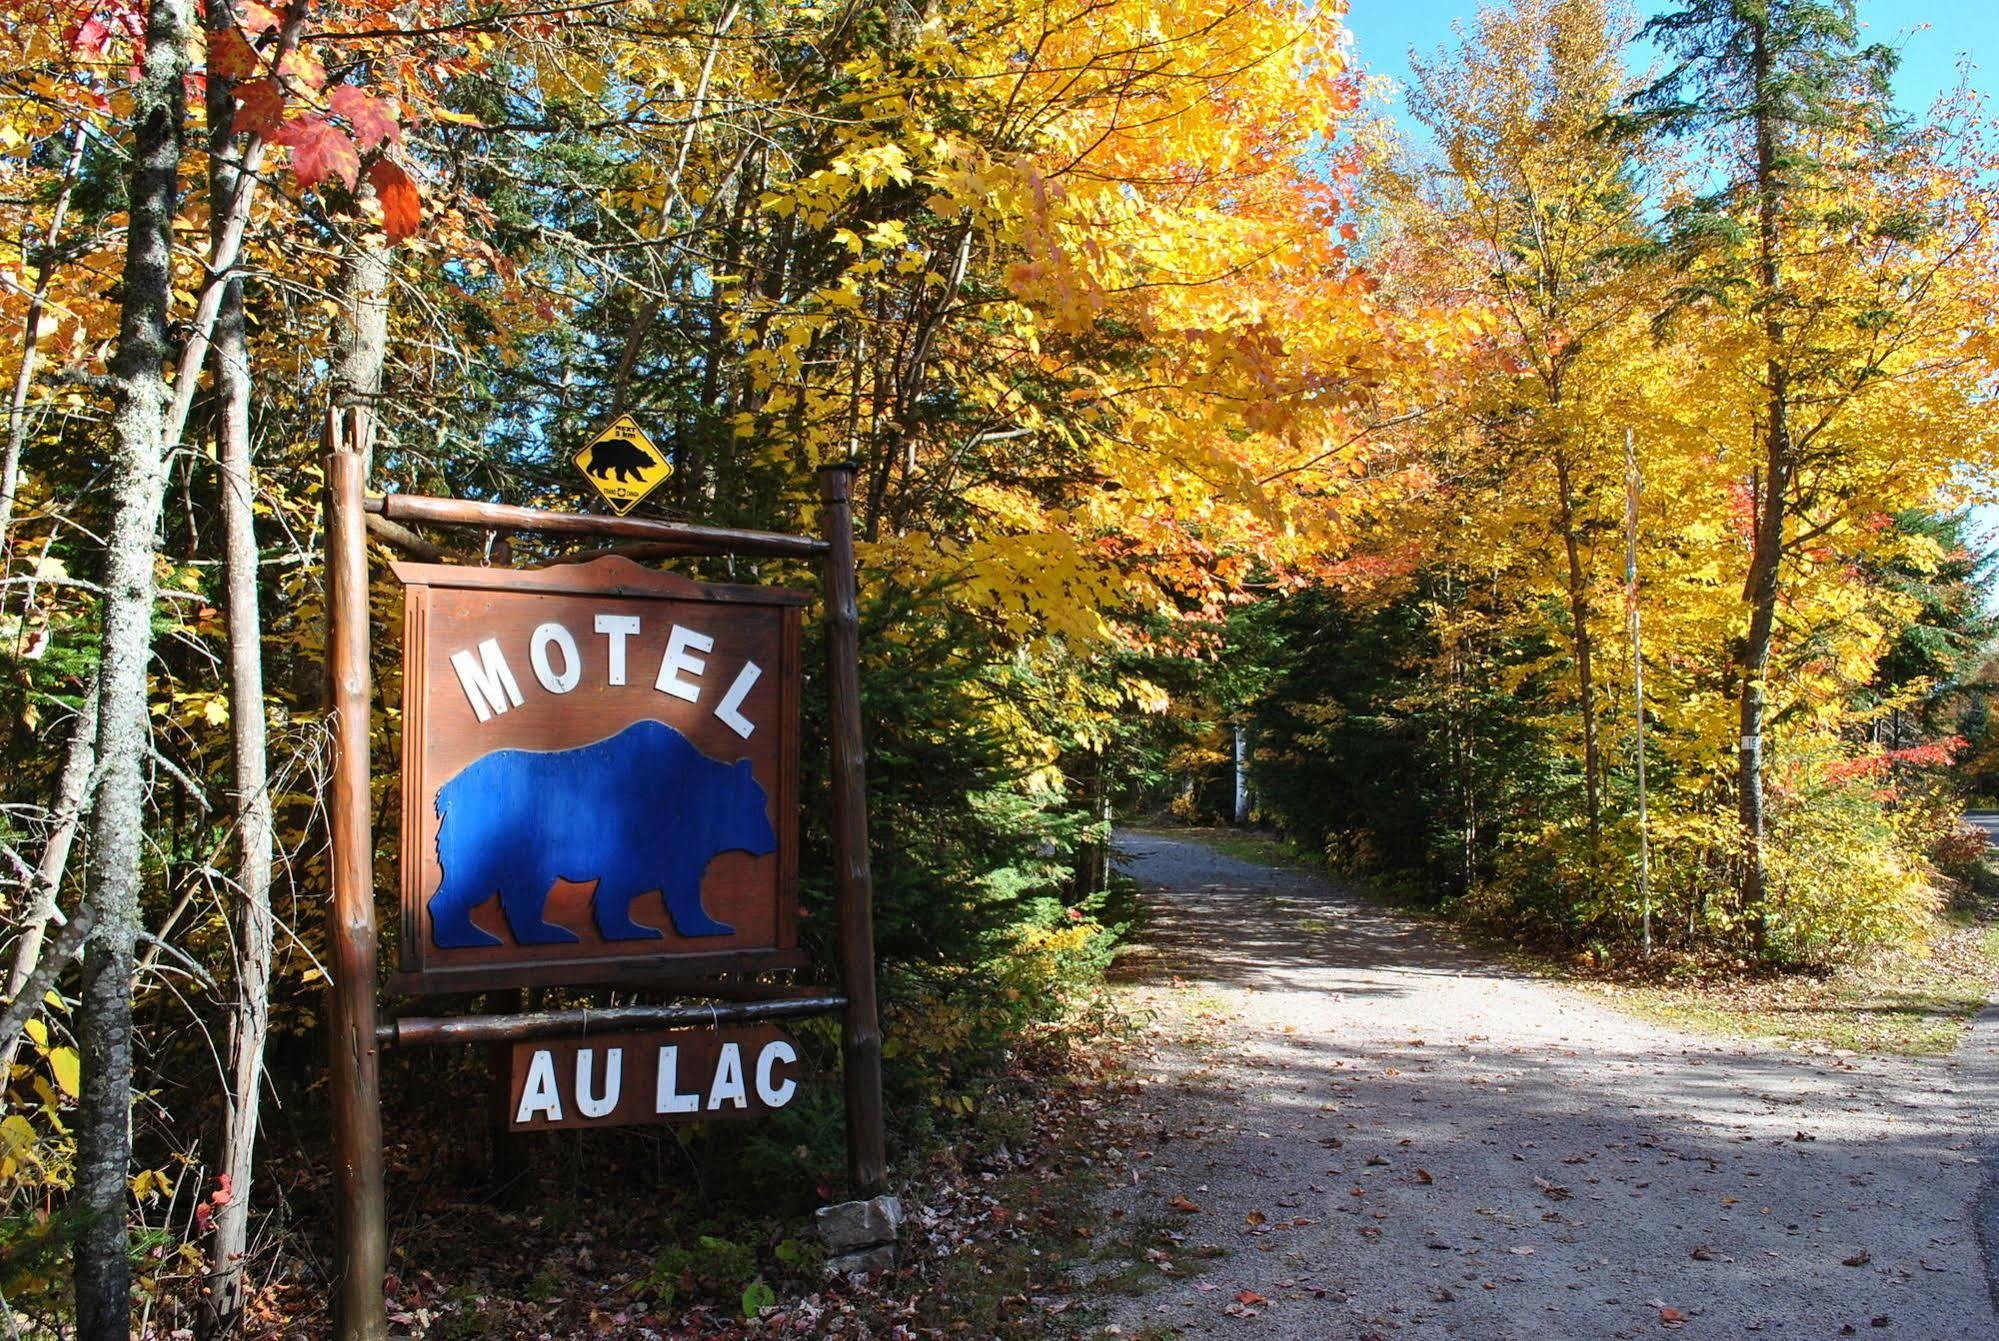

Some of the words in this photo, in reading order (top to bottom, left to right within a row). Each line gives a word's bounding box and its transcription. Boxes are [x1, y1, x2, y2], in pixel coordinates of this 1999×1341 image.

[449, 614, 763, 740] MOTEL
[516, 1048, 622, 1123] AU
[656, 1040, 798, 1114] LAC
